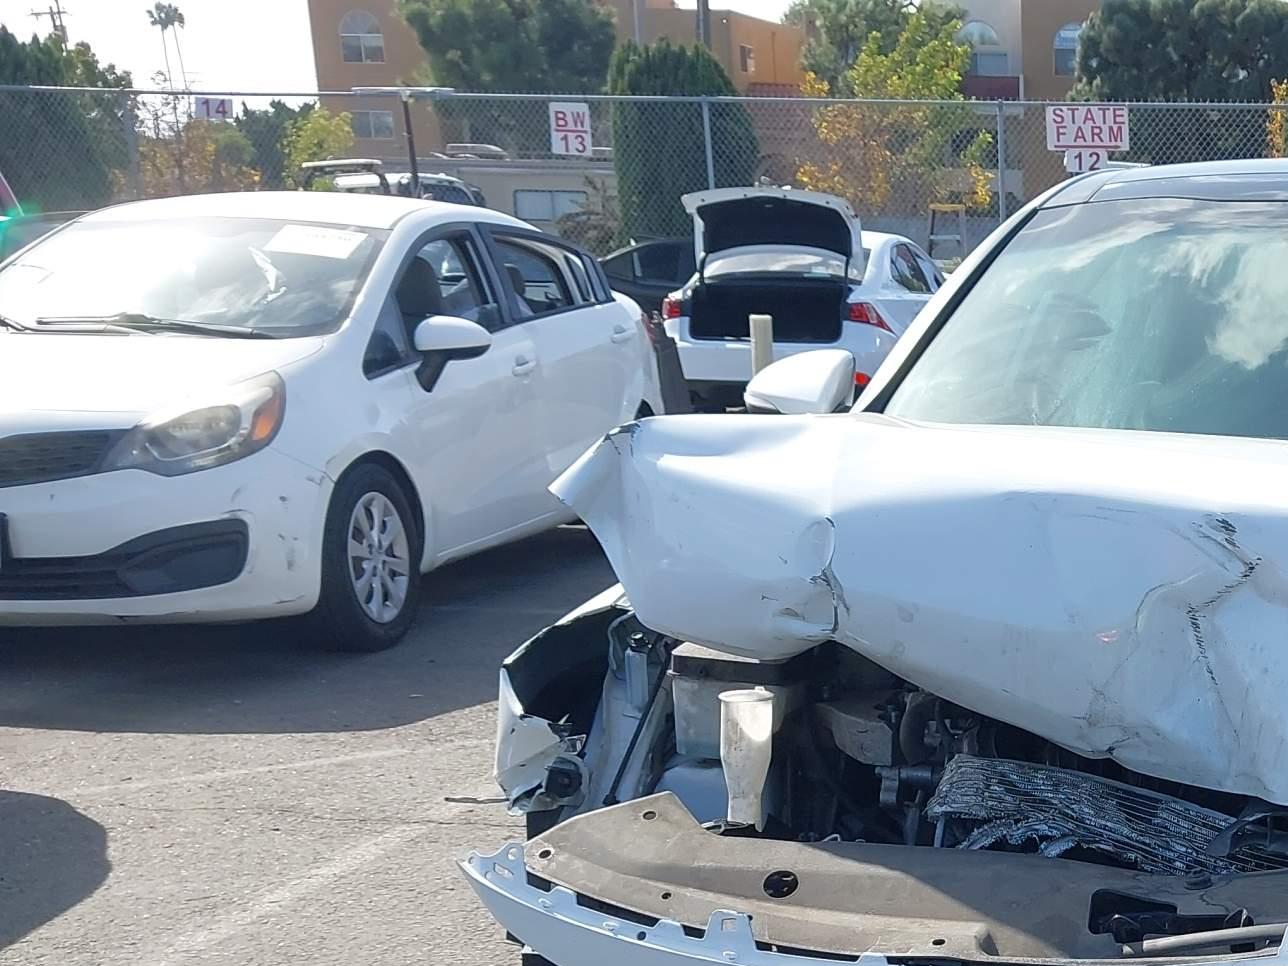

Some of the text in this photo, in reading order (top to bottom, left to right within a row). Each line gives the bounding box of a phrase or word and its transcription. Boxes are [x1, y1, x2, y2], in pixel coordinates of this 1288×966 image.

[201, 99, 228, 117] 14
[1053, 107, 1125, 125] STATE
[554, 110, 586, 128] BW
[1056, 125, 1123, 142] FARM
[560, 134, 586, 153] 13
[1074, 151, 1101, 171] 12
